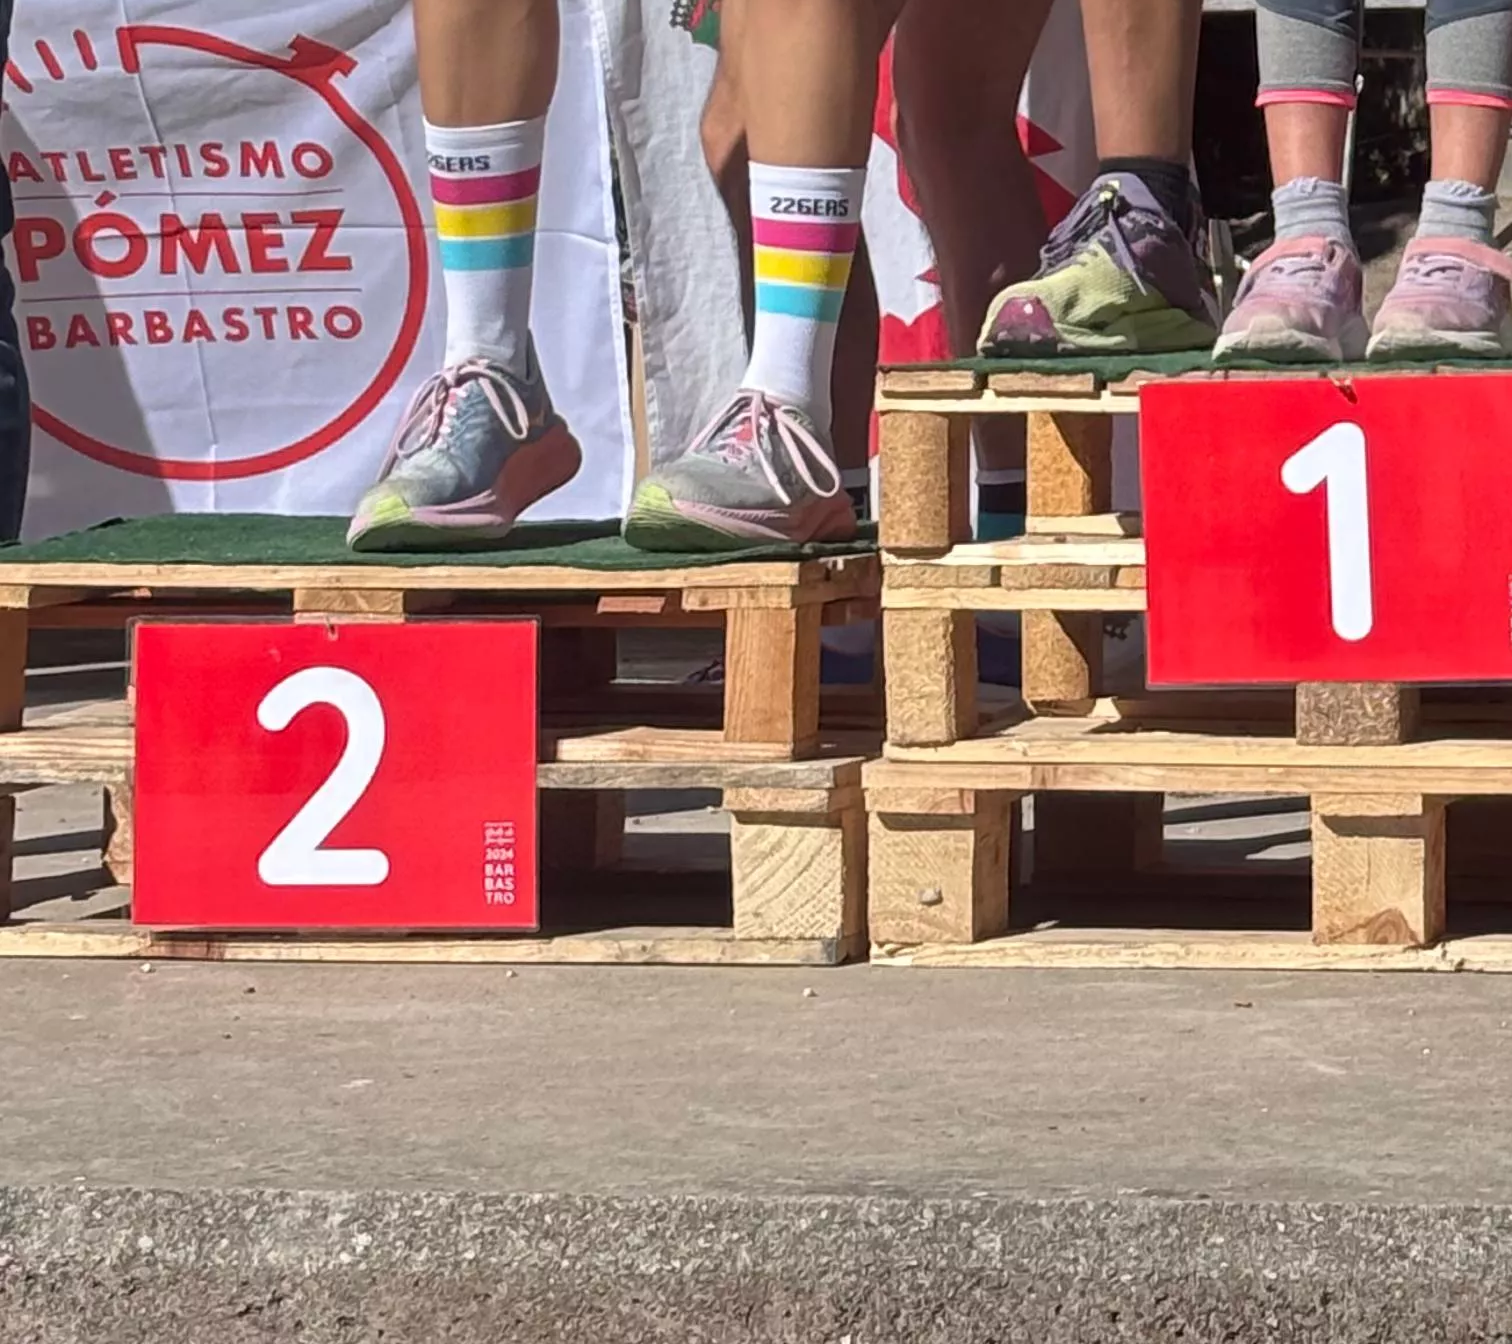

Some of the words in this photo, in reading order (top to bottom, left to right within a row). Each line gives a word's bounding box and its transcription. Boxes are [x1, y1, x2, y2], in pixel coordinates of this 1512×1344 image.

[9, 141, 333, 183] ATLETISMO
[770, 196, 849, 217] 226ERS
[12, 190, 353, 282] PÓMEZ
[27, 305, 363, 350] BARBASTRO
[1281, 421, 1373, 641] 1
[257, 666, 389, 885] 2
[484, 863, 514, 876] BAR
[484, 877, 515, 890] BAS
[484, 891, 515, 905] TRO
